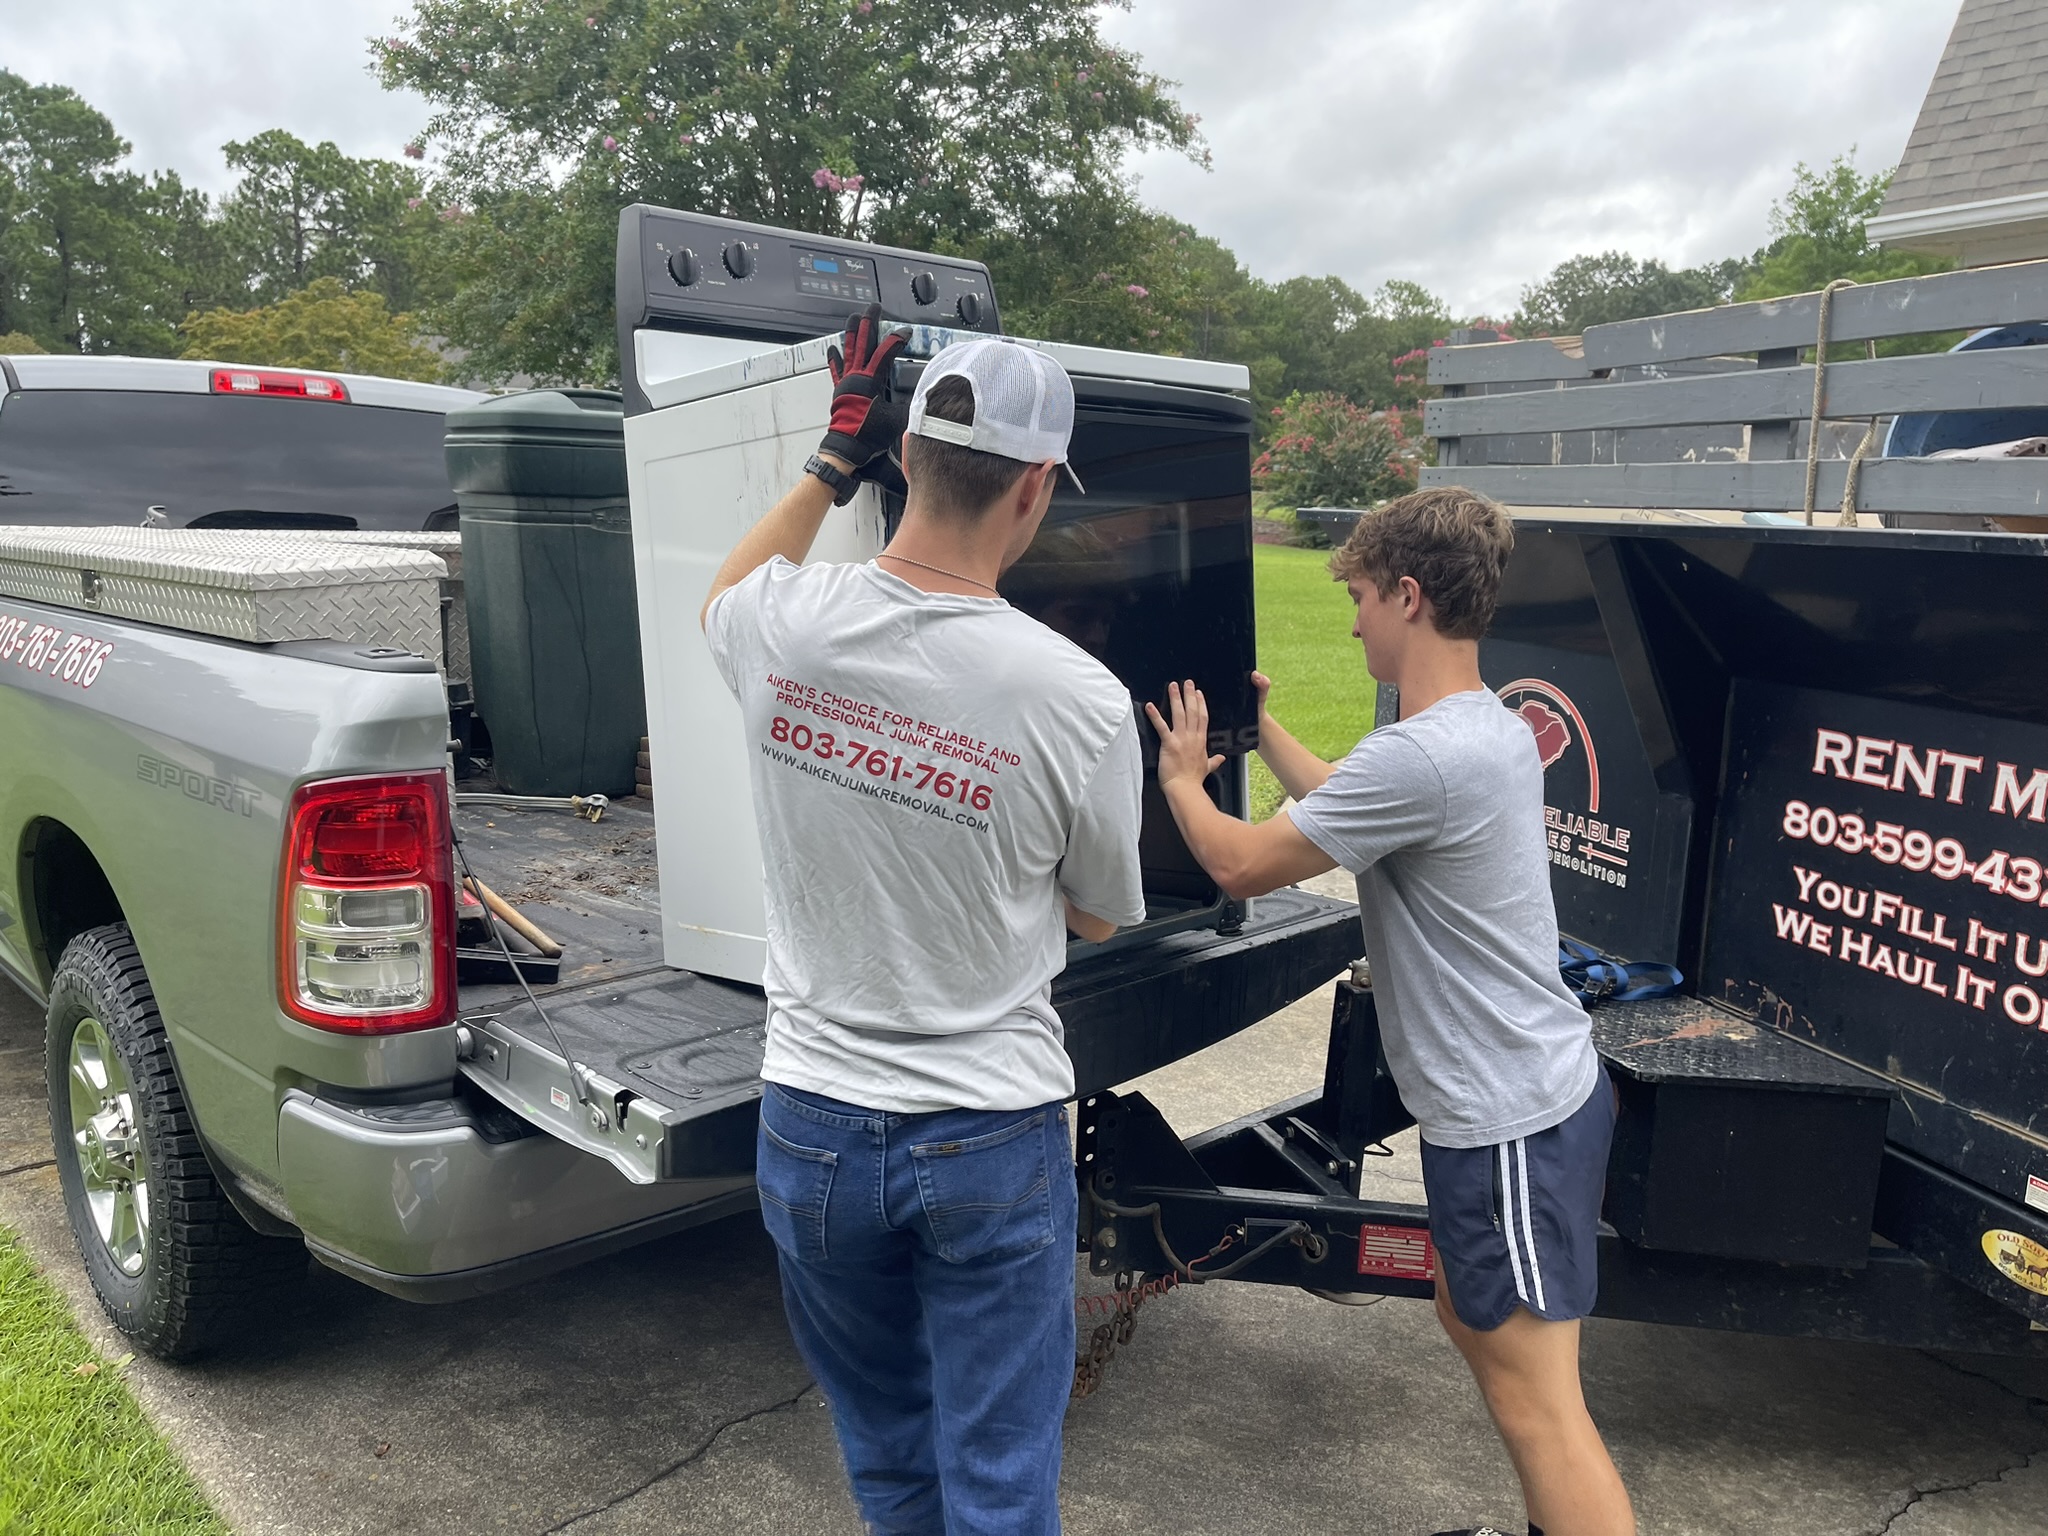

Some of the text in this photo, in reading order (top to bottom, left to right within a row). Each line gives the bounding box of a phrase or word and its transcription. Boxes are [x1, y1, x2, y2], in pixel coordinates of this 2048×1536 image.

[766, 673, 1021, 767] AIKEN'S CHOICE FOR RELIABLE AND
[776, 691, 1000, 774] PROFESSIONAL JUNK REMOVAL
[136, 754, 262, 818] SPORT
[761, 742, 989, 834] WWW.AIKENJUNKREMOVAL.COM
[770, 715, 994, 811] 803-761-7616
[1812, 728, 1984, 805] RENT
[1997, 1233, 2020, 1244] OLD
